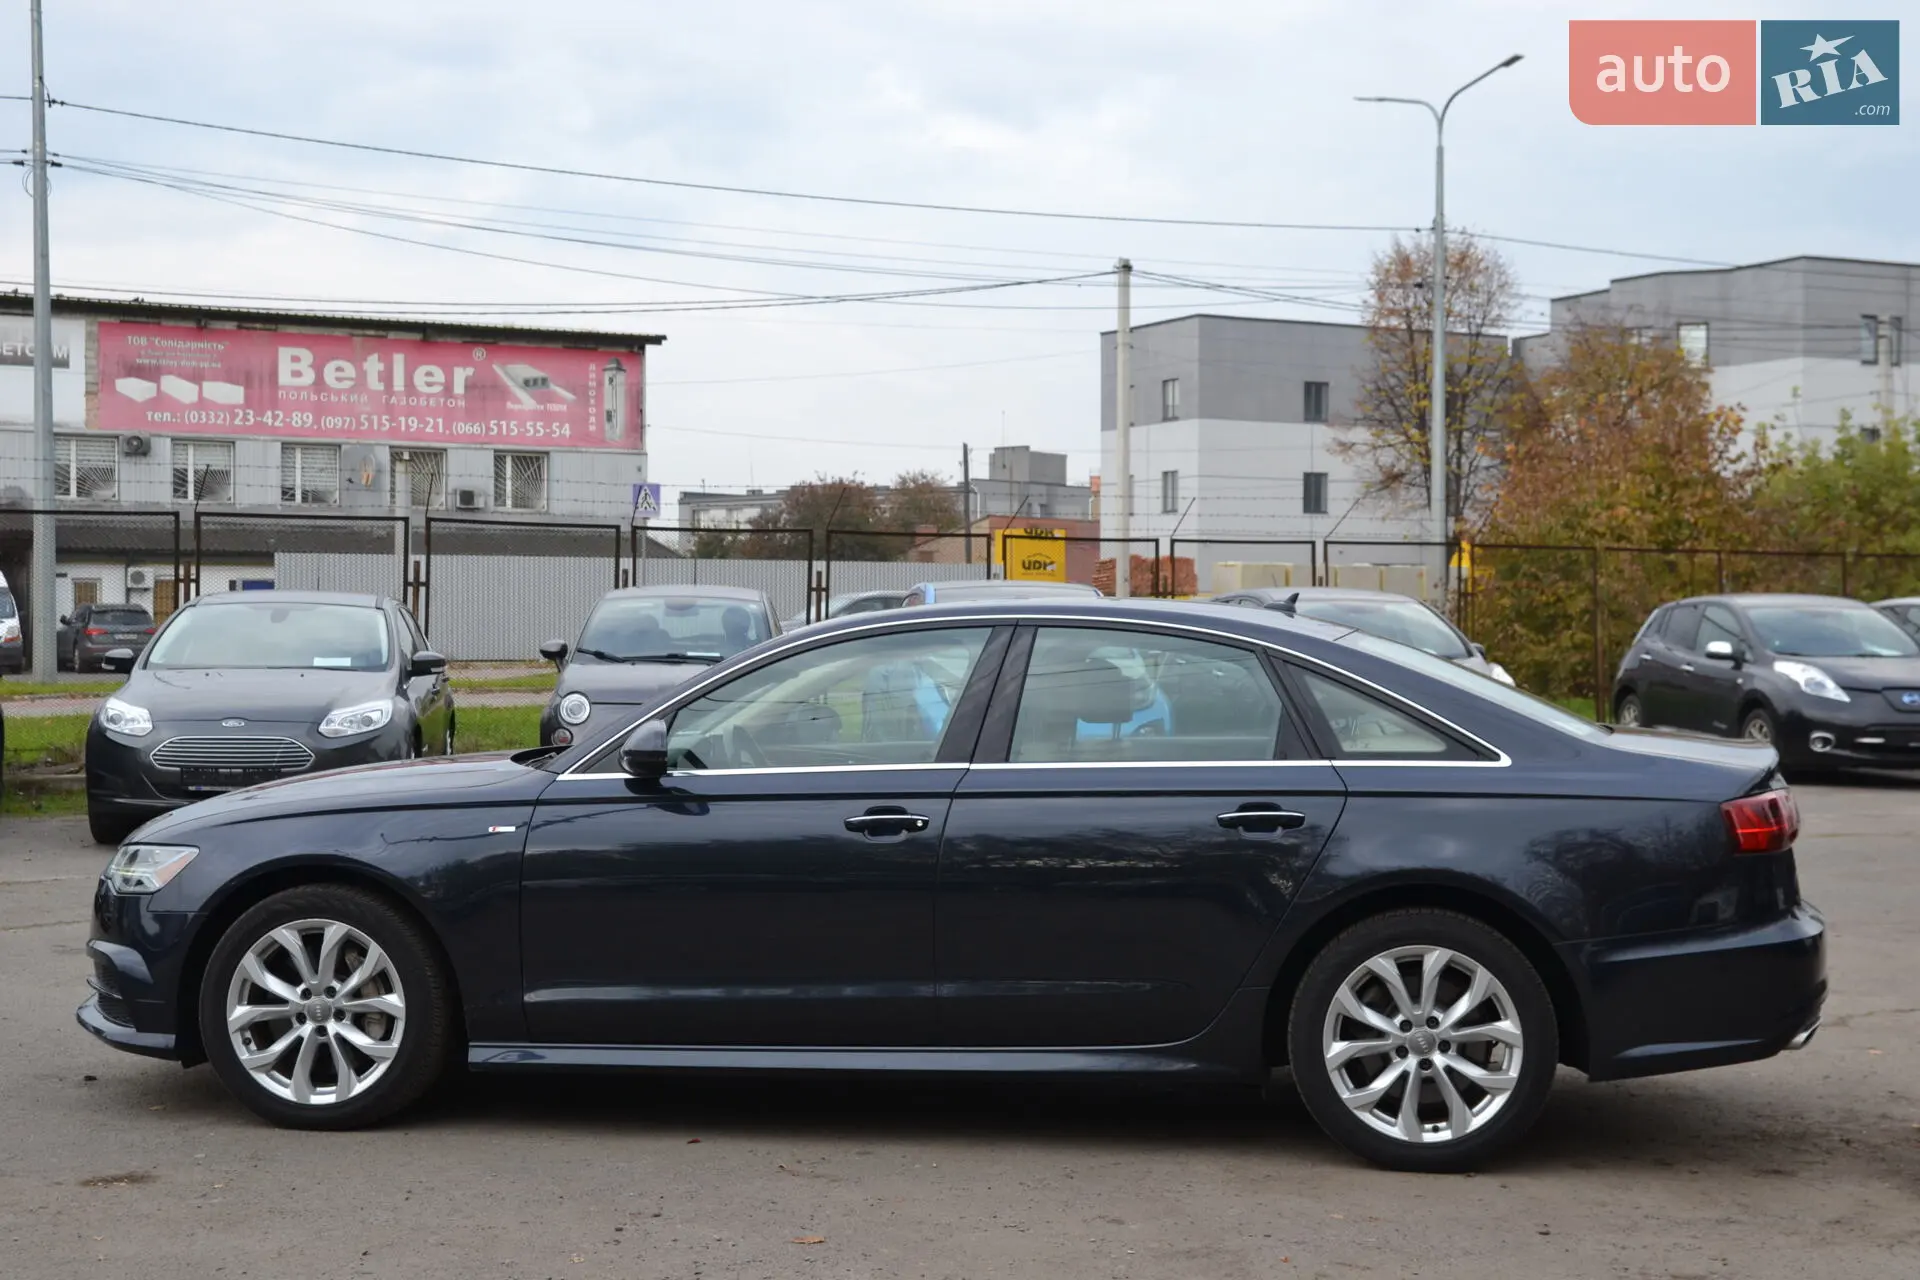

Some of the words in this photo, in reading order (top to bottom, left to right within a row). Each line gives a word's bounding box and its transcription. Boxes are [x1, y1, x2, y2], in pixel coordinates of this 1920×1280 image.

[127, 335, 148, 346] ТОВ
[278, 346, 475, 394] Betler
[278, 390, 369, 404] ПОЛЬСЬКИЙ
[382, 395, 466, 408] ГАЗОБЕТОН
[145, 410, 181, 423] тел.:
[184, 410, 230, 426] (0332)
[320, 415, 356, 431] (097)
[452, 421, 486, 436] (066)
[489, 420, 571, 438] 515-55-54
